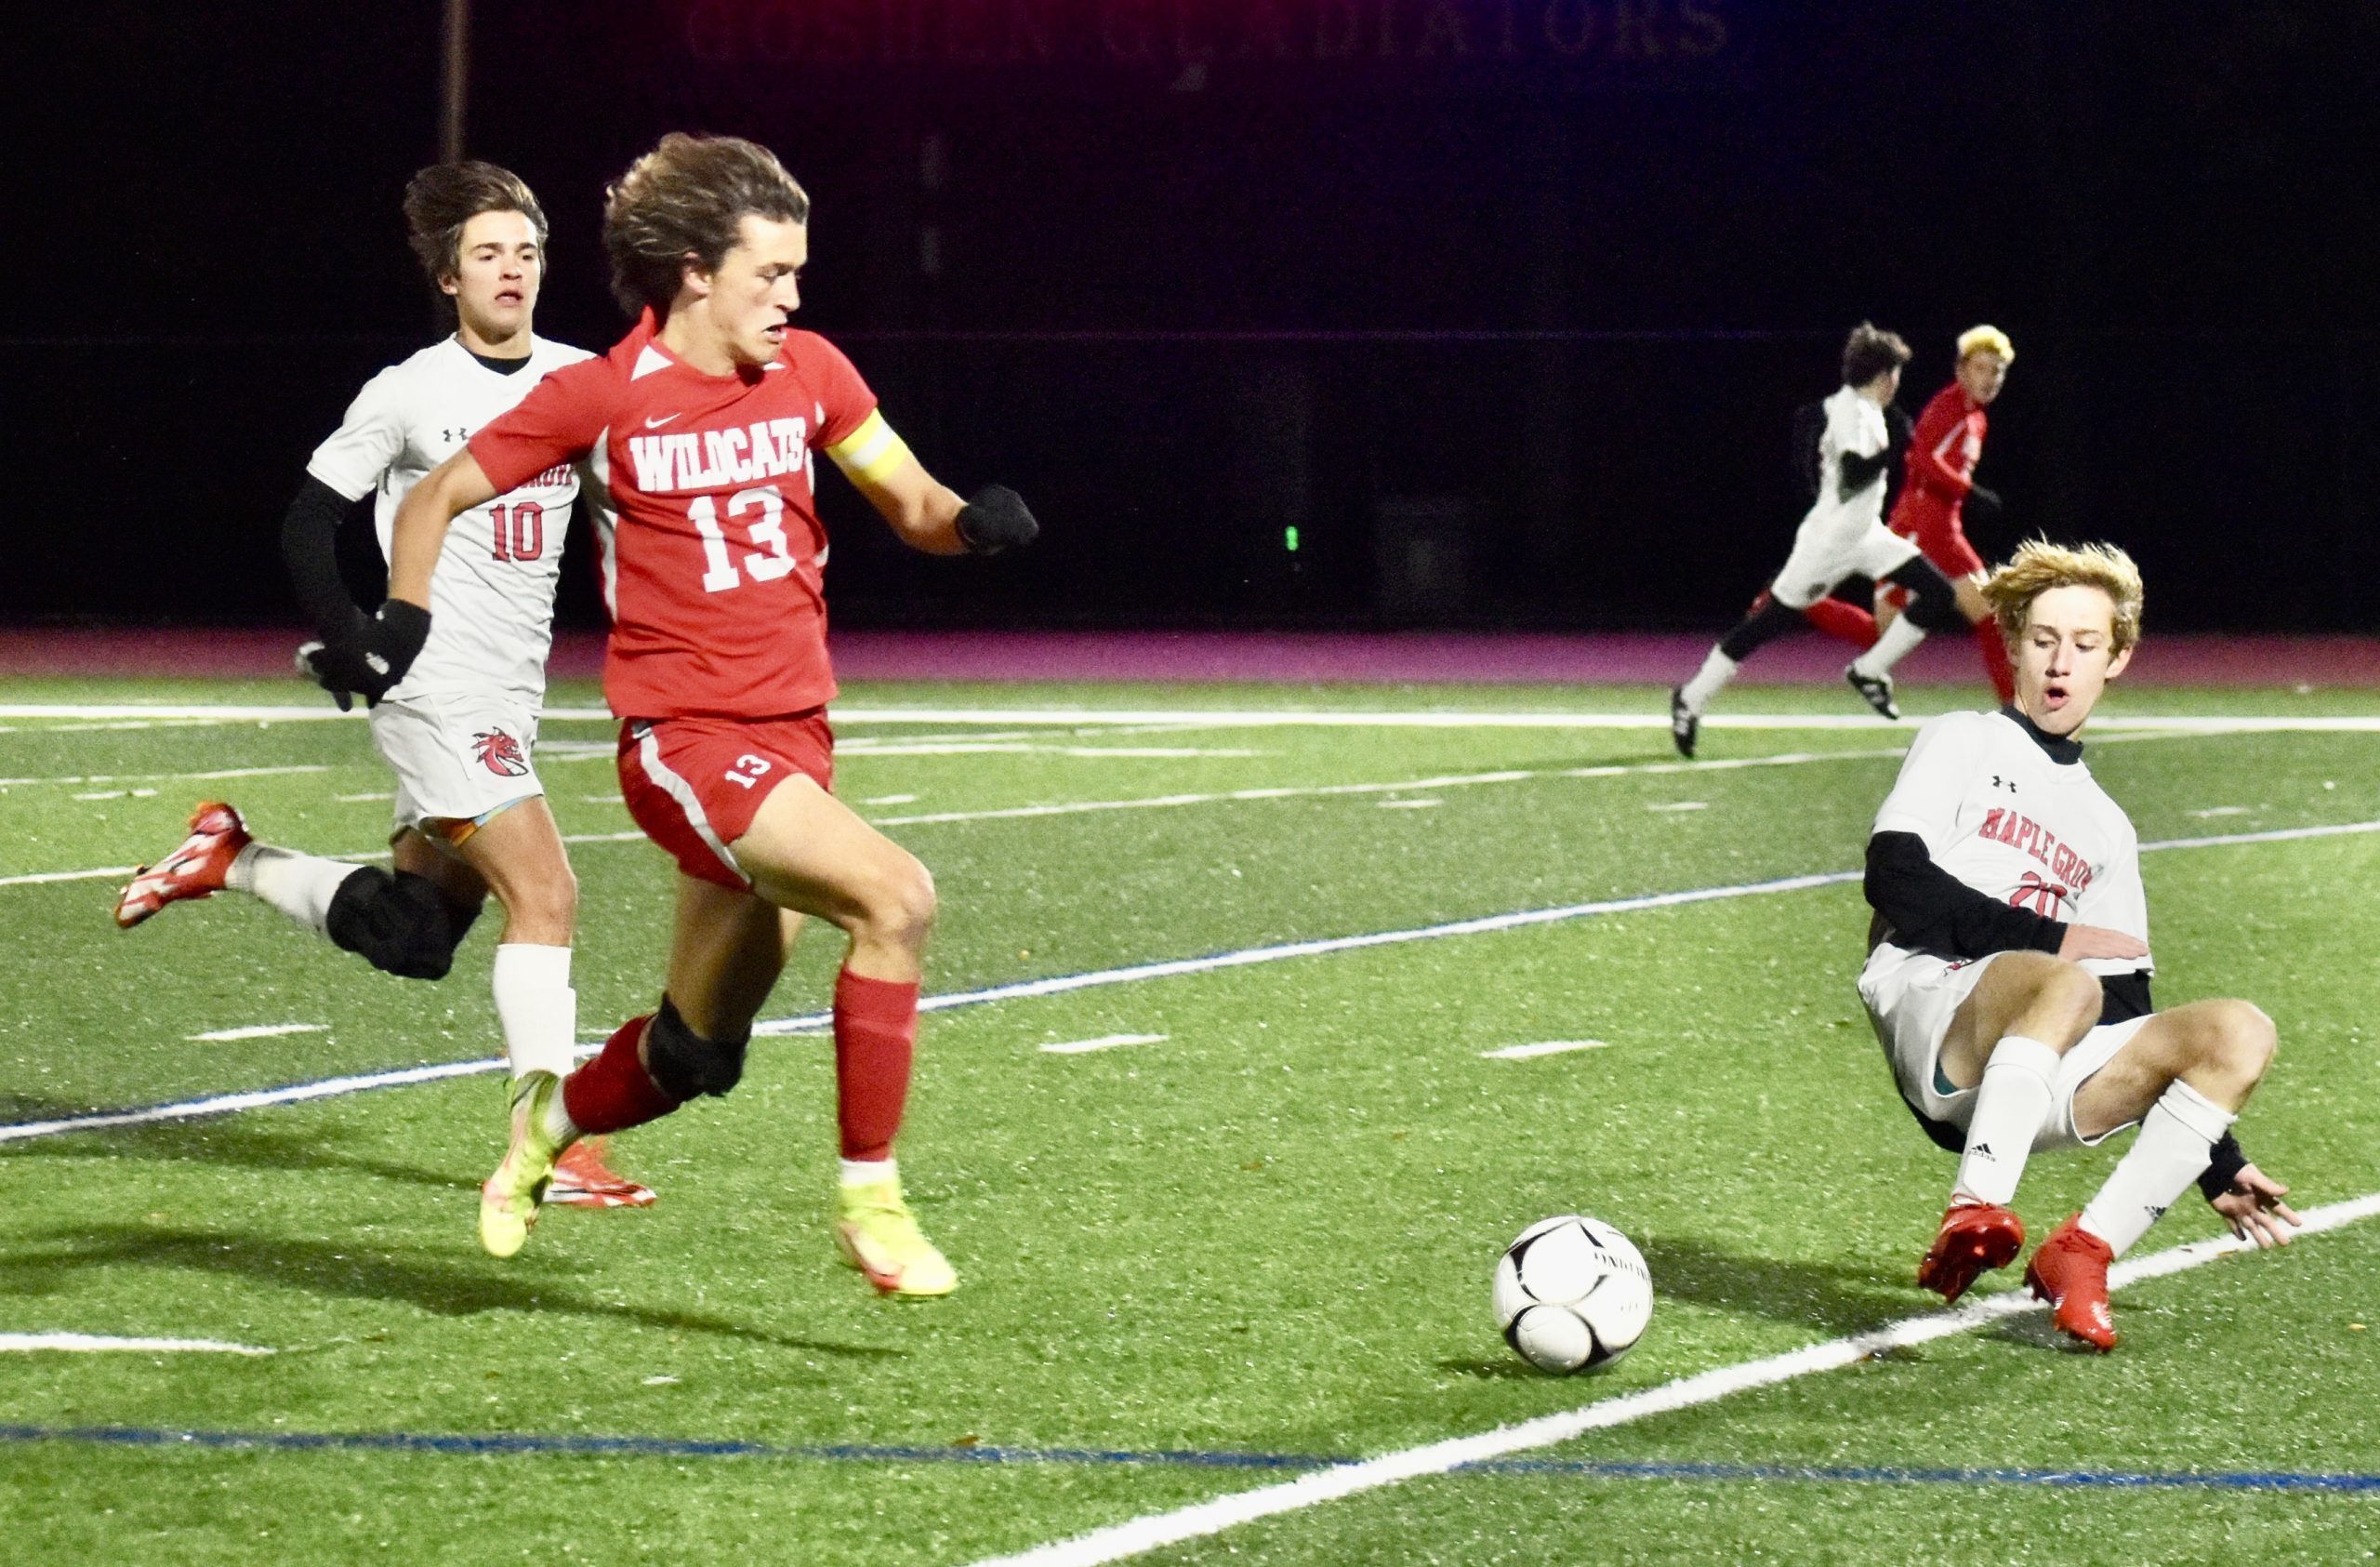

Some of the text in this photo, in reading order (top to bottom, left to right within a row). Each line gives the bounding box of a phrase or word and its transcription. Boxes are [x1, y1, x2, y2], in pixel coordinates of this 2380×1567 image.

[683, 0, 1729, 61] GOSHEN GLADIATORS
[628, 416, 808, 492] WILDCATS
[488, 501, 544, 562] 10
[686, 485, 797, 593] 13
[724, 754, 772, 790] 13
[1977, 806, 2056, 866] MAPLE
[2009, 870, 2068, 922] 20
